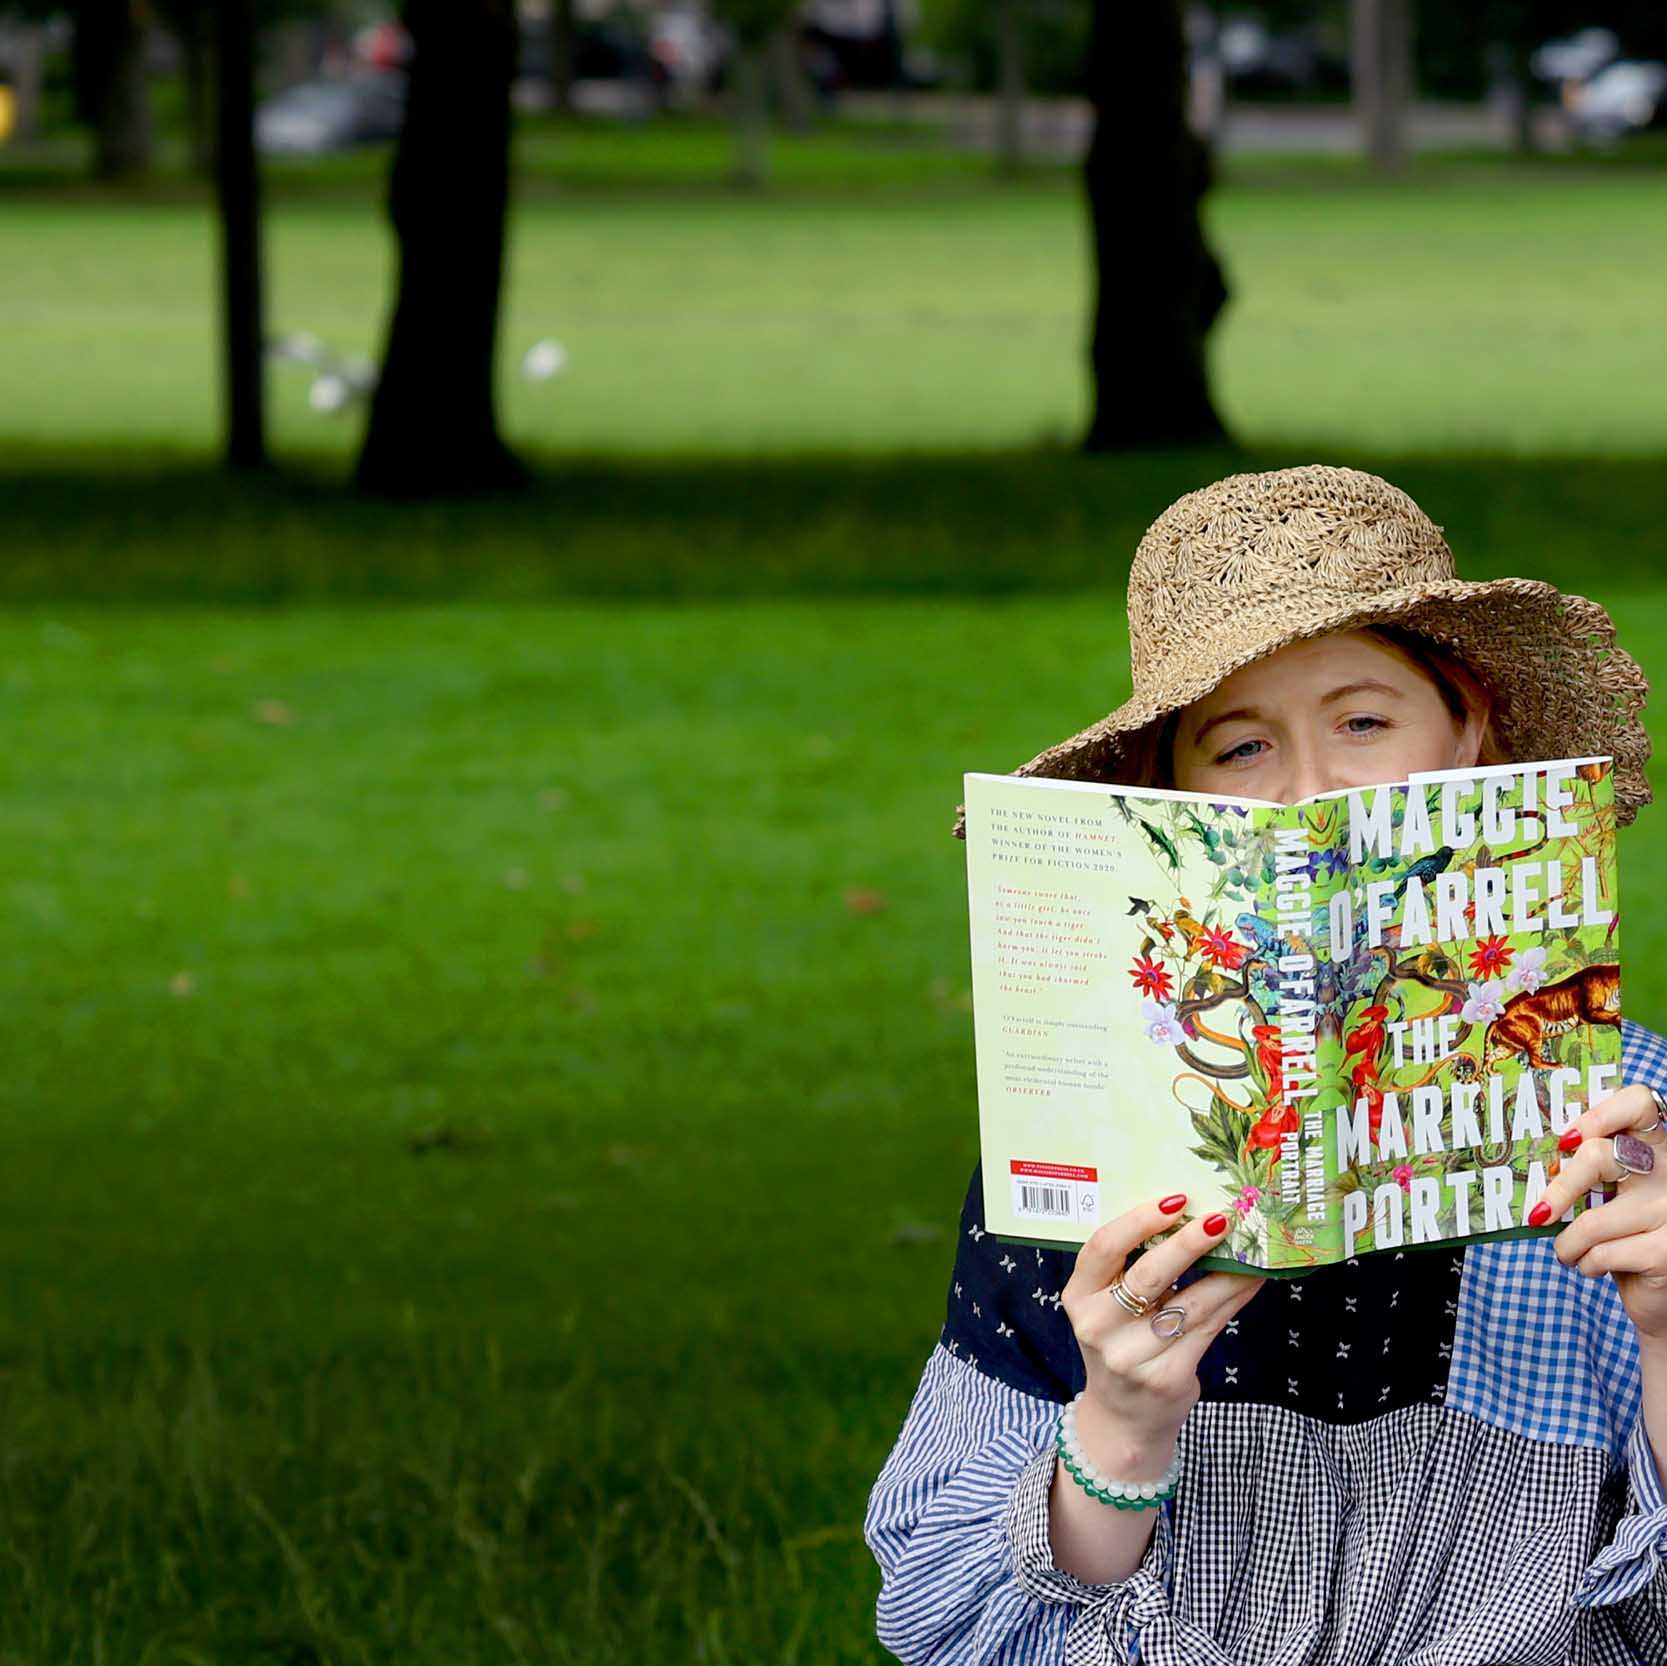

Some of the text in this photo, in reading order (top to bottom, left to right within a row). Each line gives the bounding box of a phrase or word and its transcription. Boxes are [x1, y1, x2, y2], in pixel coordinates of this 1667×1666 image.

[1347, 766, 1580, 863] MAGGIE
[1329, 857, 1613, 963] O'FARRELL
[1273, 828, 1319, 1106] MAGGIE O'FARRELL
[1387, 1014, 1461, 1070] THE
[1280, 1131, 1300, 1203] PORTRAIT
[1304, 1111, 1326, 1221] THE MARRIAGE
[1335, 1063, 1617, 1173] MARRIAGE
[1343, 1158, 1600, 1260] PORTRA
